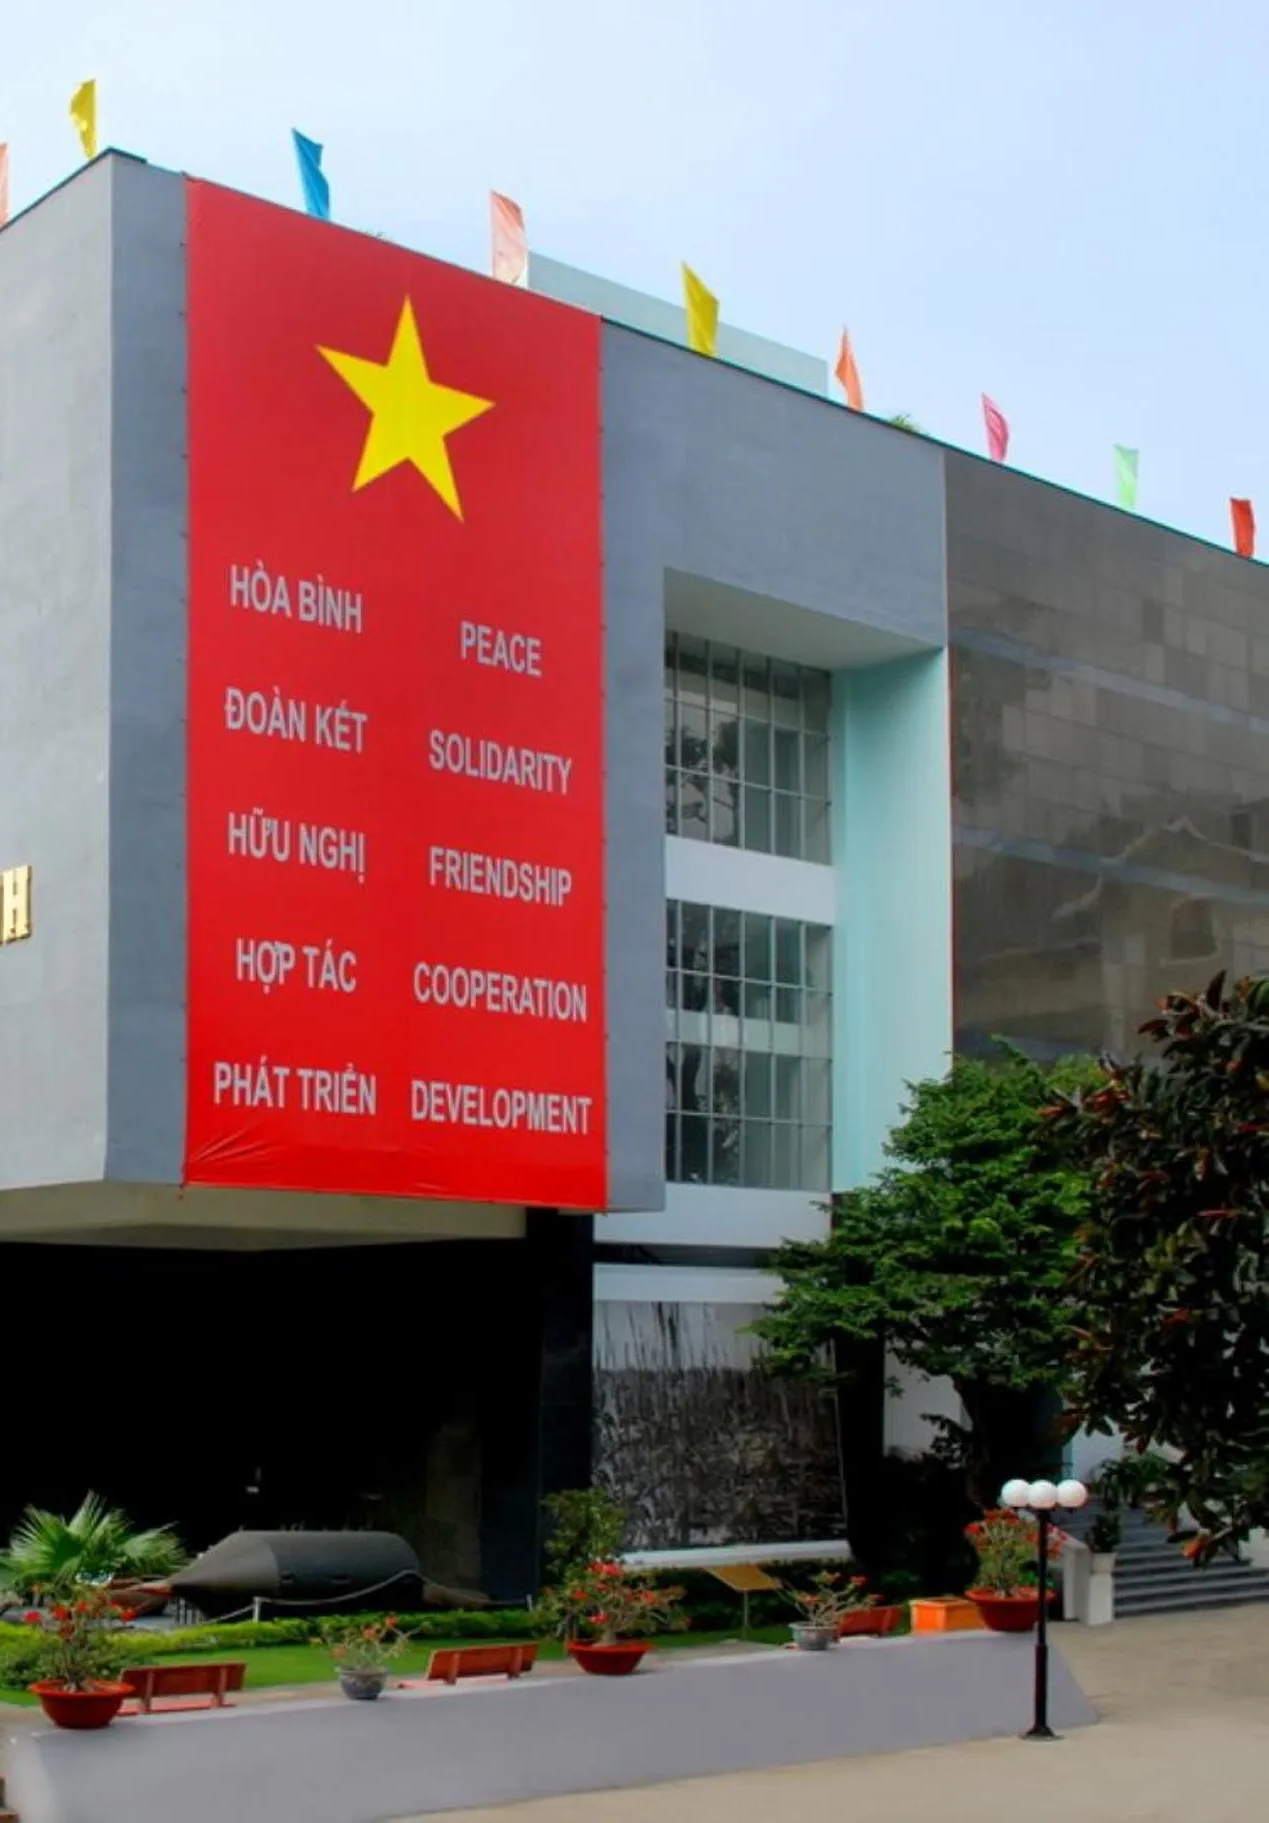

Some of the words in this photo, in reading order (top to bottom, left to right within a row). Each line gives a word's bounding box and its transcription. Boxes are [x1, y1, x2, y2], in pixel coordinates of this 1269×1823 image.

[230, 560, 292, 617] HÒA
[298, 575, 363, 633] BÌNH
[461, 621, 542, 676] PEACE
[225, 686, 306, 742] ĐOÀN
[429, 729, 573, 794] SOLIDARITY
[228, 807, 291, 862] HỮU
[299, 823, 366, 884] NGHỊ
[430, 846, 572, 907] FRIENDSHIP
[236, 938, 296, 993] HỢP
[302, 939, 358, 993] TÁC
[413, 962, 588, 1022] COOPERATION
[214, 1055, 290, 1108] PHÁT
[411, 1080, 592, 1134] DEVELOPMENT
